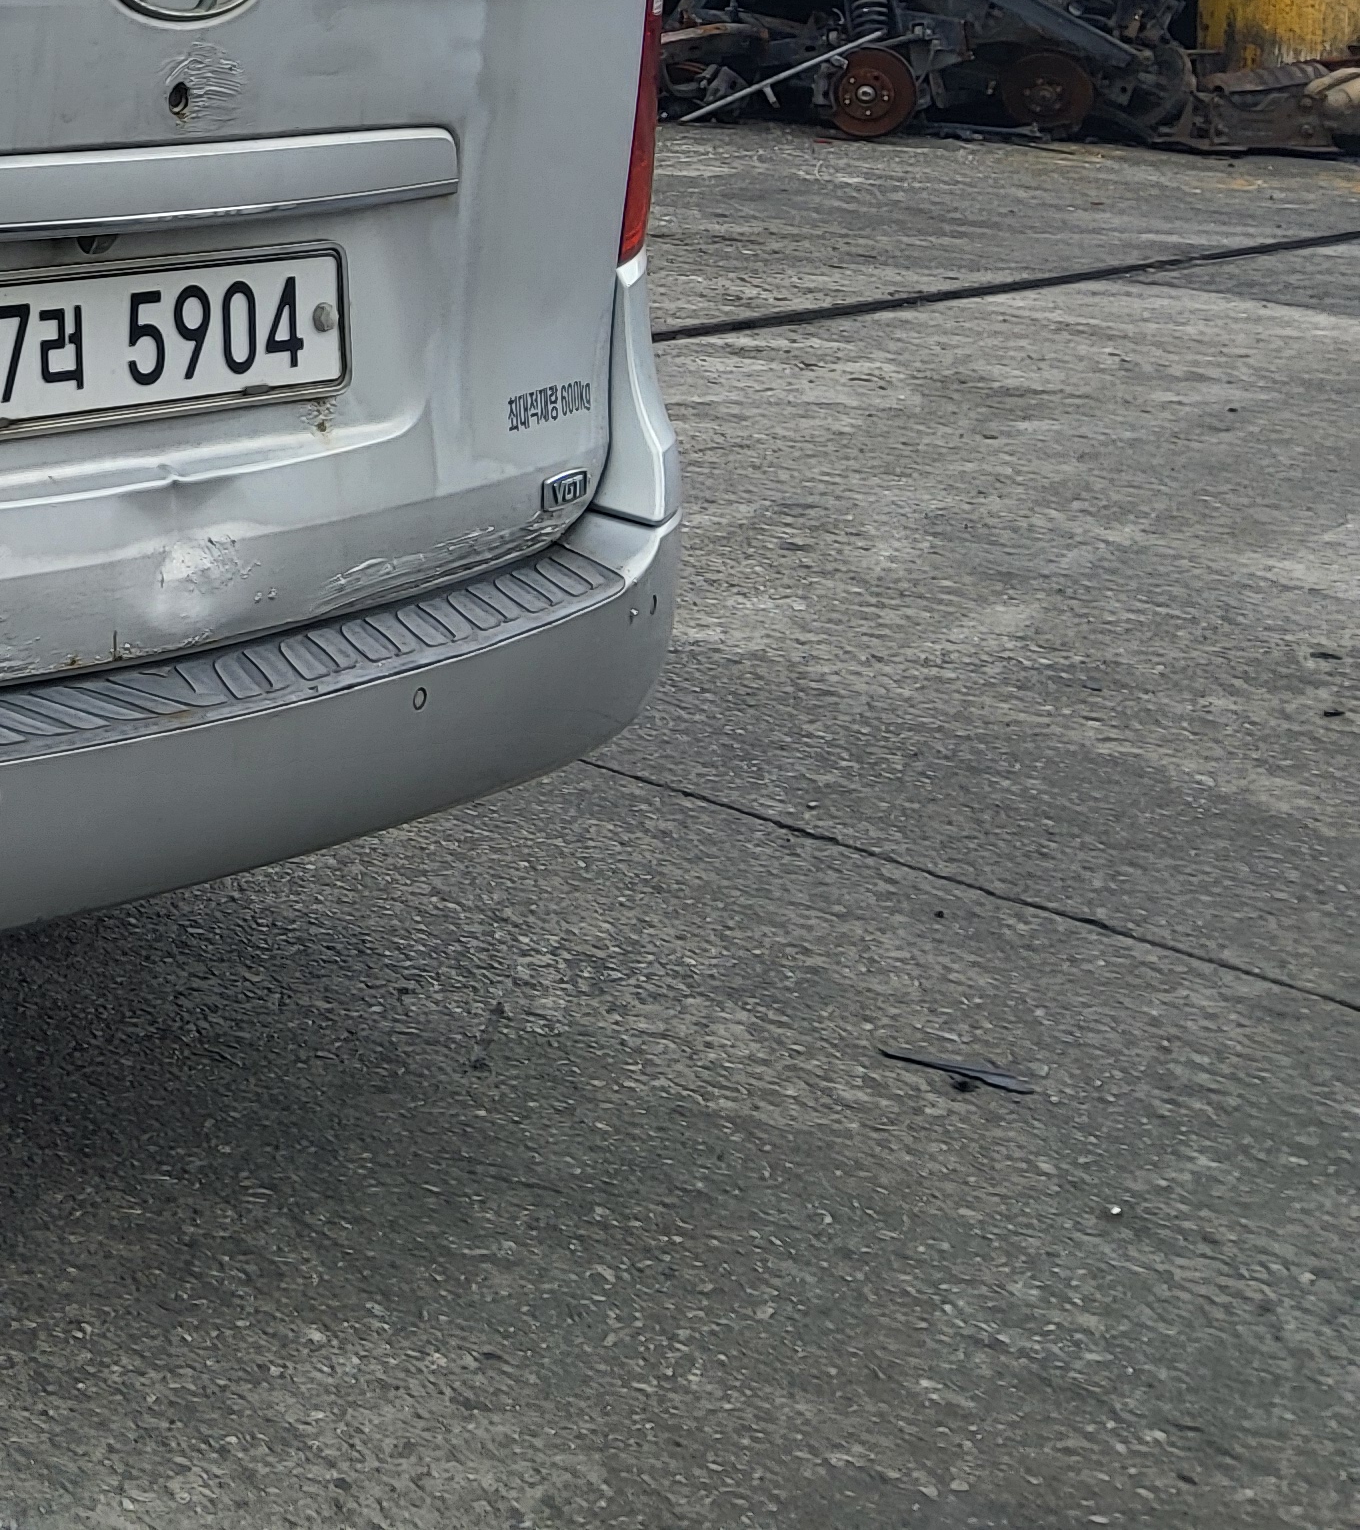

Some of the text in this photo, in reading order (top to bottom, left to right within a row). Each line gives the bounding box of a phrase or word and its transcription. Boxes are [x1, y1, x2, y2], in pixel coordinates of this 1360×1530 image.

[128, 276, 305, 386] 5904
[508, 384, 559, 432] 최대적재량
[552, 474, 584, 505] VGT
